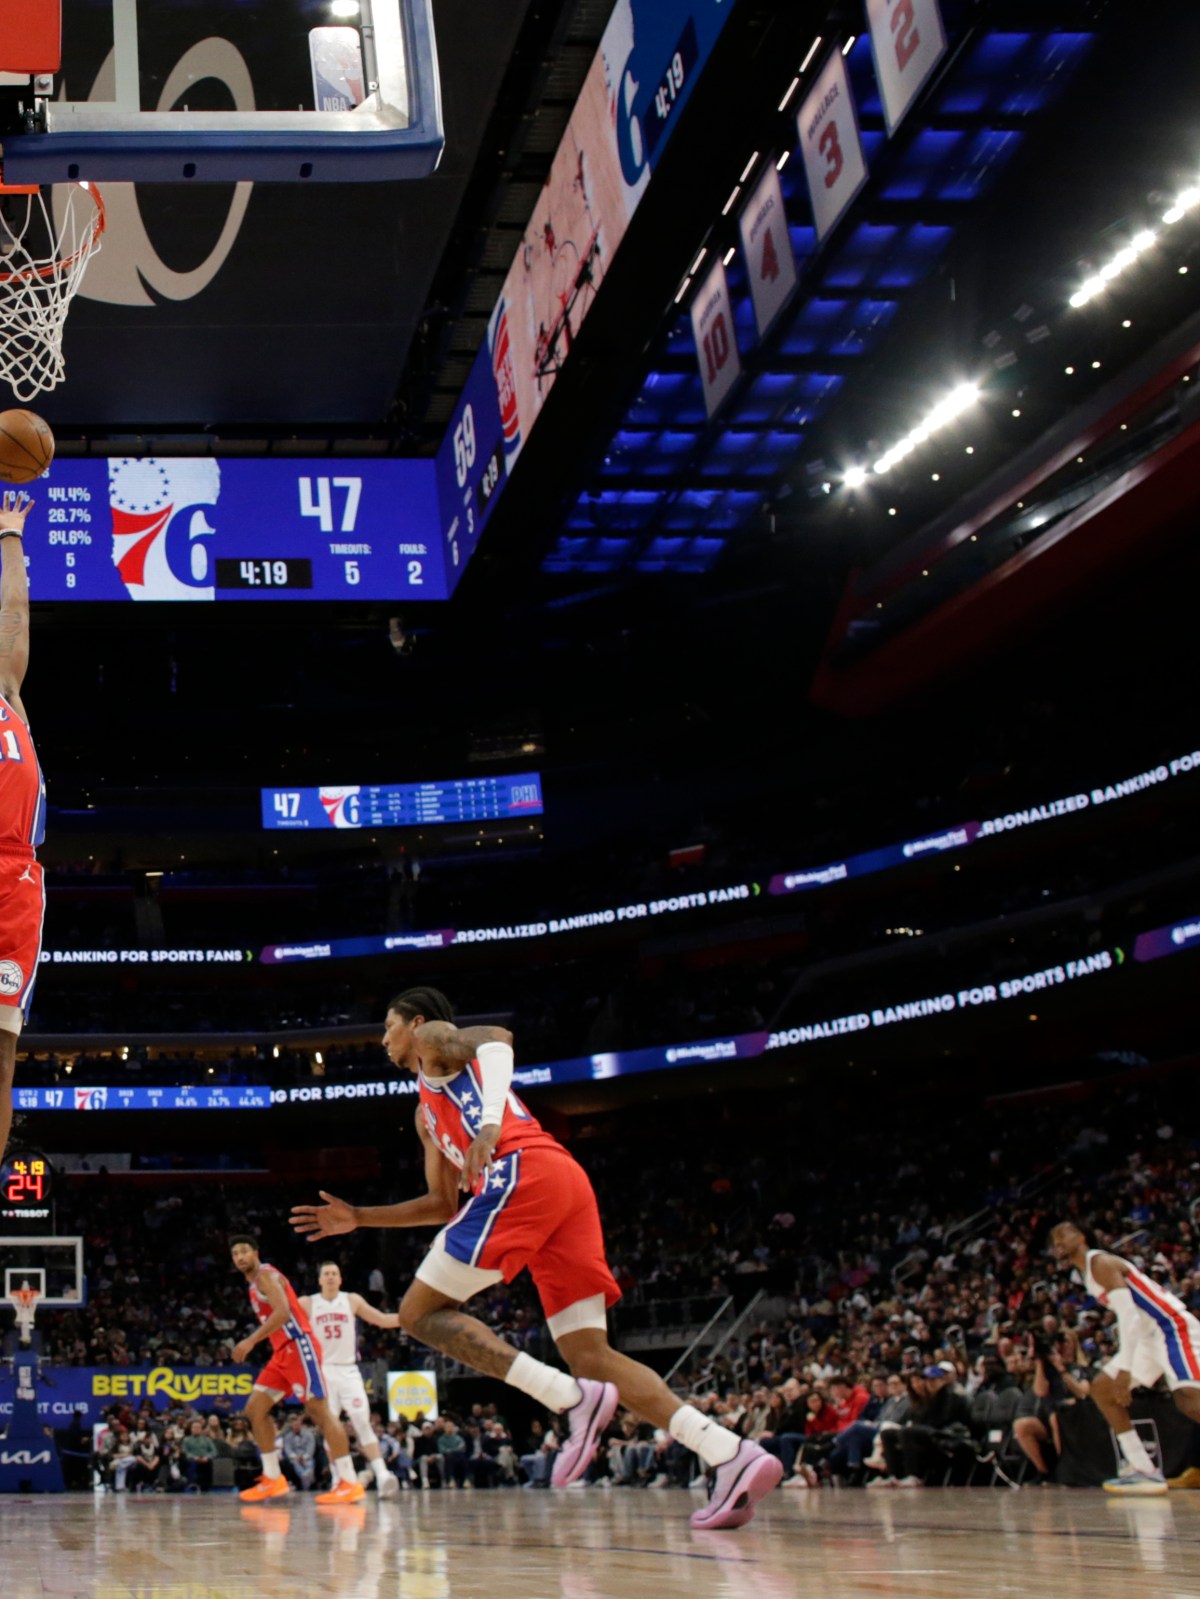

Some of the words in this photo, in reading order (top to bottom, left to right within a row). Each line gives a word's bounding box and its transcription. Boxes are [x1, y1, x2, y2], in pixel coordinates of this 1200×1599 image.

[890, 0, 920, 73] 2
[655, 52, 684, 119] 4:19
[819, 120, 843, 189] 3
[761, 226, 780, 284] 4
[703, 312, 728, 386] 10
[454, 404, 476, 488] 59
[48, 487, 91, 501] 44.4%
[298, 477, 362, 532] 47
[48, 509, 91, 522] 26.7%
[49, 530, 92, 545] 84.6%
[110, 502, 216, 587] 76
[399, 544, 427, 554] FOULS:
[66, 553, 75, 567] 5
[66, 573, 76, 587] 9
[240, 562, 288, 585] 4:19
[345, 562, 360, 584] 5
[408, 562, 423, 584] 2
[976, 794, 1089, 838] RSONALIZED
[1091, 766, 1168, 805] BANKING
[1170, 751, 1200, 776] FOR
[274, 793, 300, 817] 47
[321, 794, 360, 825] 76
[451, 922, 547, 944] RSONALIZED
[549, 909, 615, 933] BANKING
[618, 903, 647, 920] FOR
[649, 893, 706, 915] SPORTS
[709, 884, 749, 904] FANS
[53, 951, 118, 962] BANKING
[120, 951, 148, 962] FOR
[151, 950, 204, 962] SPORTS
[206, 950, 242, 962] FANS
[765, 1013, 870, 1049] RSONALIZED
[873, 994, 955, 1026] BANKING
[958, 985, 997, 1008] FOR
[999, 967, 1065, 998] SPORTS
[1066, 951, 1112, 979] FANS
[45, 1090, 63, 1107] 47
[77, 1090, 105, 1110] 76
[290, 1088, 322, 1102] FOR
[325, 1083, 385, 1099] SPORTS
[14, 1161, 44, 1175] 4:19
[8, 1175, 42, 1200] 24
[14, 1209, 49, 1218] TISSOT
[324, 1325, 342, 1339] 55
[92, 1367, 252, 1401] BETRIVERS
[52, 1402, 89, 1414] CLUB
